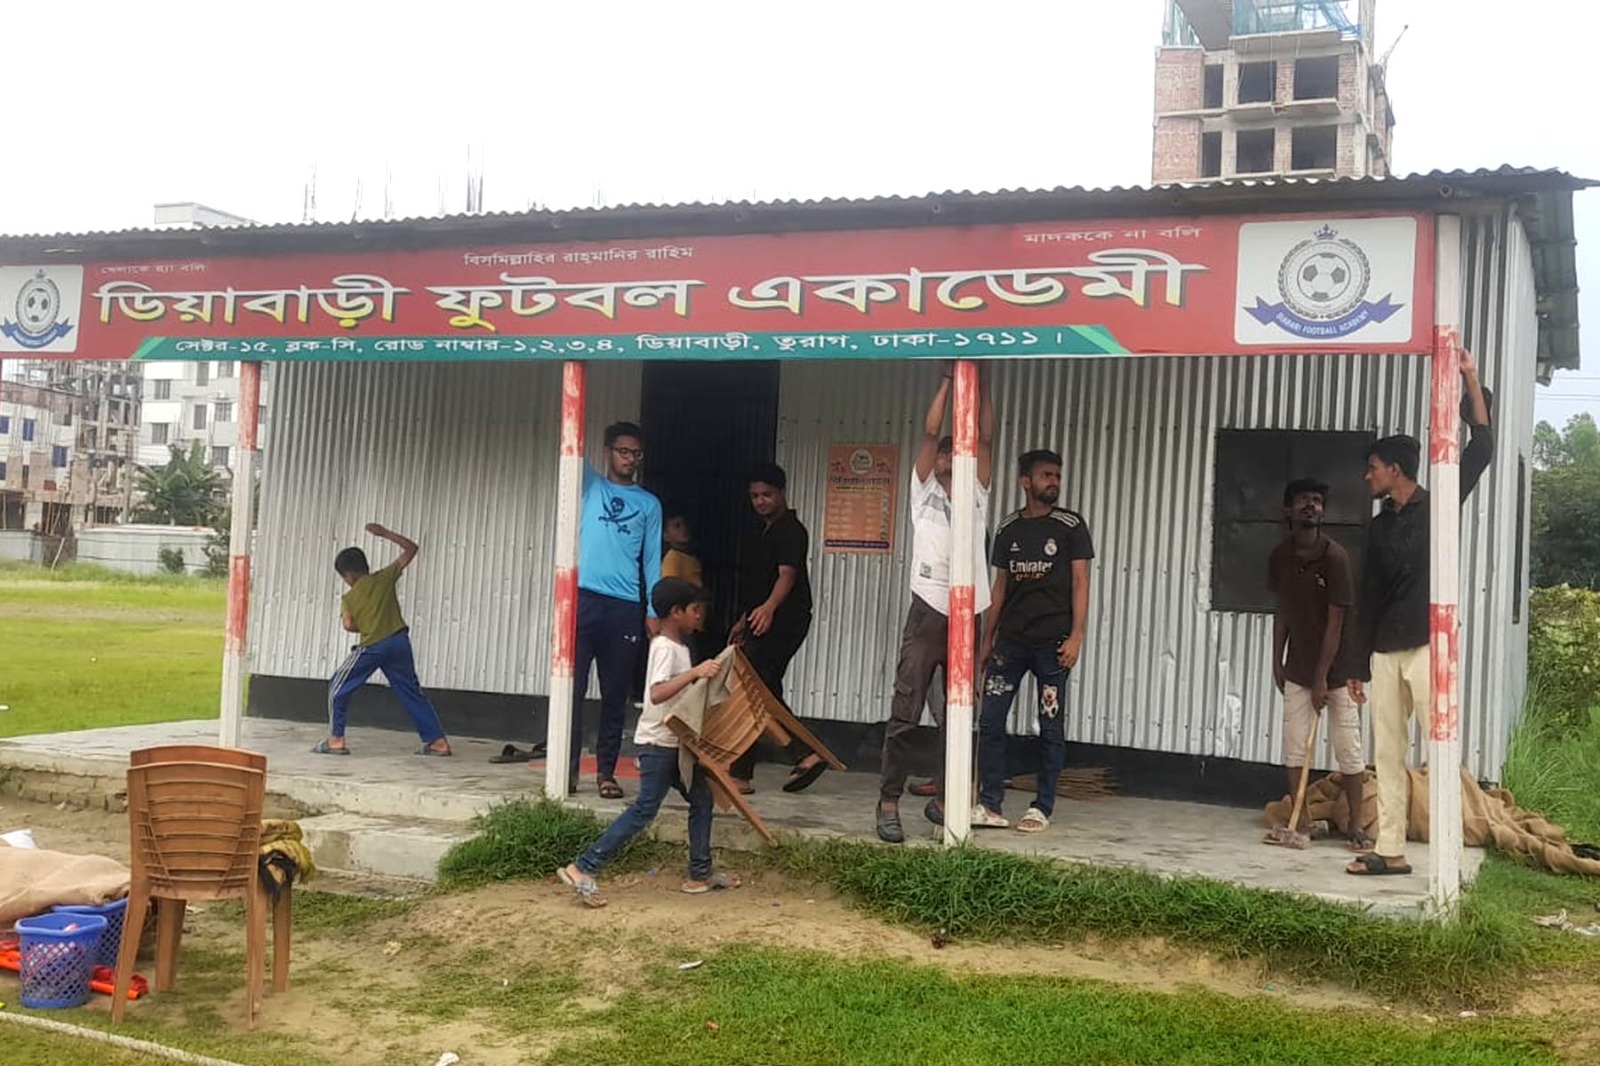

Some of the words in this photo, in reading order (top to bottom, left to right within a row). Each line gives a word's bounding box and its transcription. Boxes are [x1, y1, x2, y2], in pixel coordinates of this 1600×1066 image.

[1123, 229, 1147, 240] না
[93, 274, 411, 329] ডিয়াবাড়ী
[425, 271, 706, 332] ফুটবল
[728, 248, 1211, 316] একাডেমী
[1302, 325, 1338, 336] FOOTBALL
[1338, 309, 1371, 333] ACADEMY
[373, 339, 428, 352] রোড
[771, 333, 859, 352] তুরাগ,
